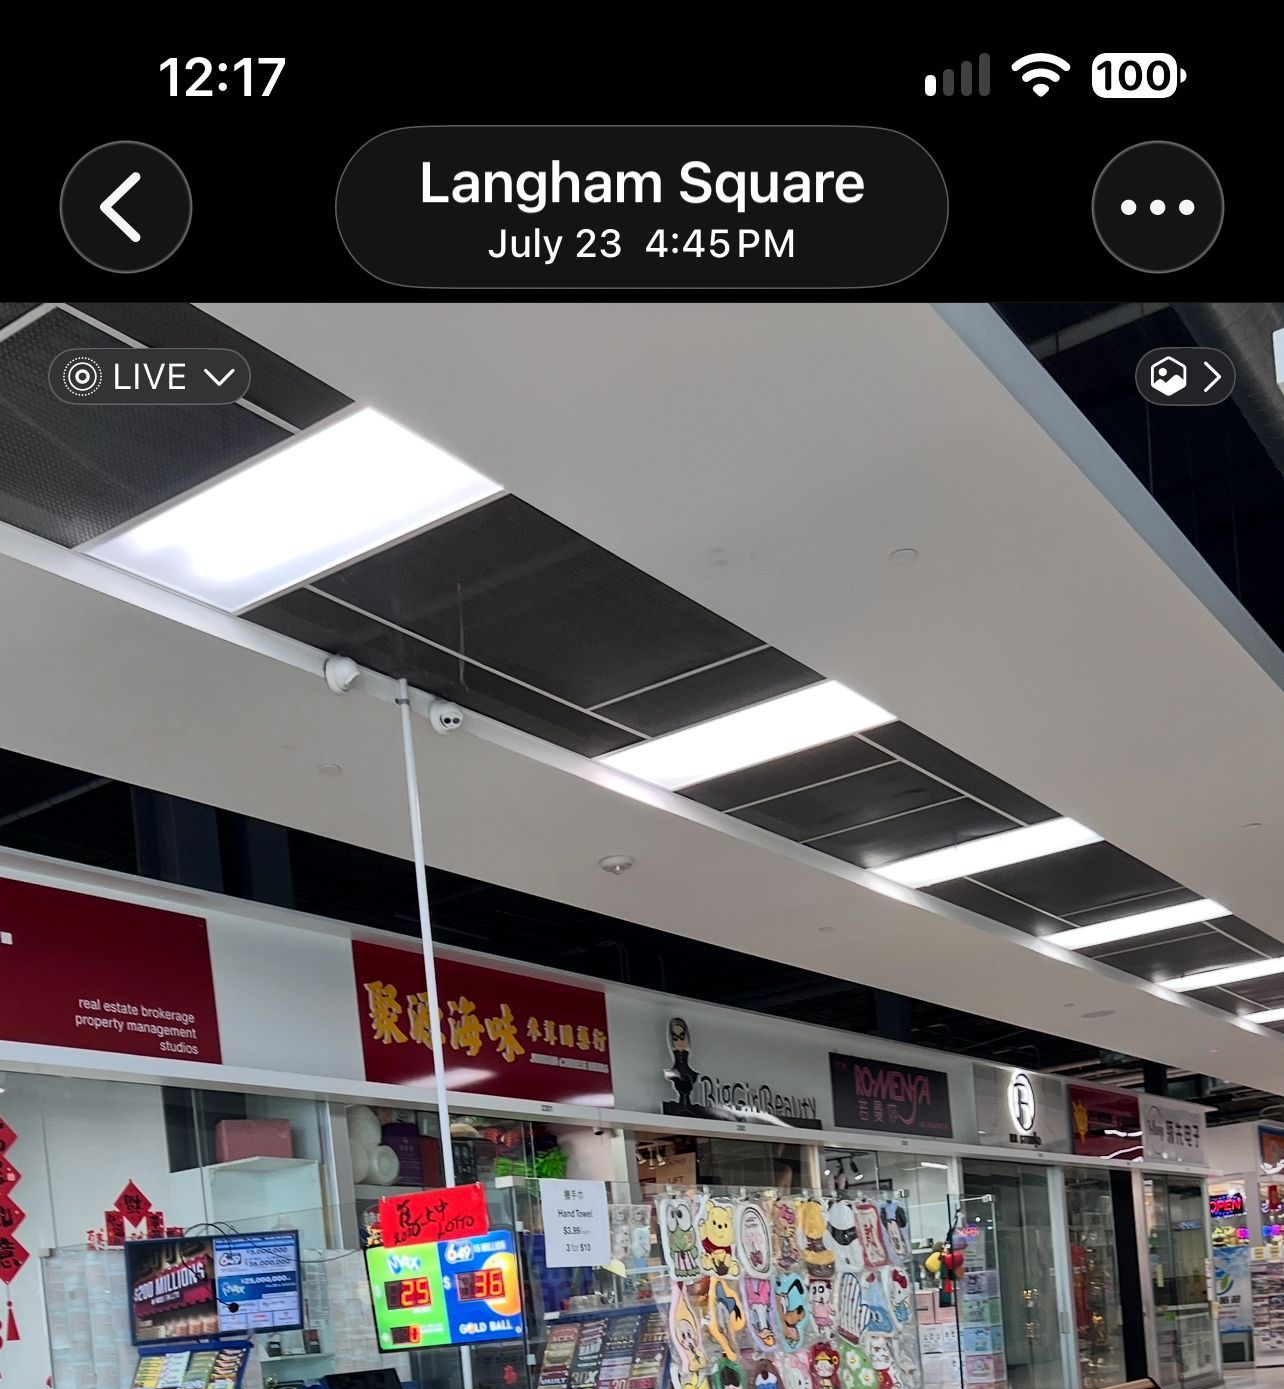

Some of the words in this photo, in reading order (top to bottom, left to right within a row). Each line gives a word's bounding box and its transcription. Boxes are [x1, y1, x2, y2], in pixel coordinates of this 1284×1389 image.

[78, 998, 101, 1011] real
[103, 1001, 139, 1016] estate
[141, 1005, 195, 1026] brokerage
[75, 1014, 124, 1032] property
[127, 1021, 197, 1039] management
[160, 1041, 199, 1055] studios
[558, 1209, 575, 1218] Hand
[576, 1209, 593, 1218] Towel
[566, 1243, 571, 1252] 3
[580, 1243, 591, 1252] $10
[401, 1278, 431, 1307] 25
[474, 1269, 503, 1298] 36
[489, 1320, 513, 1333] BALL
